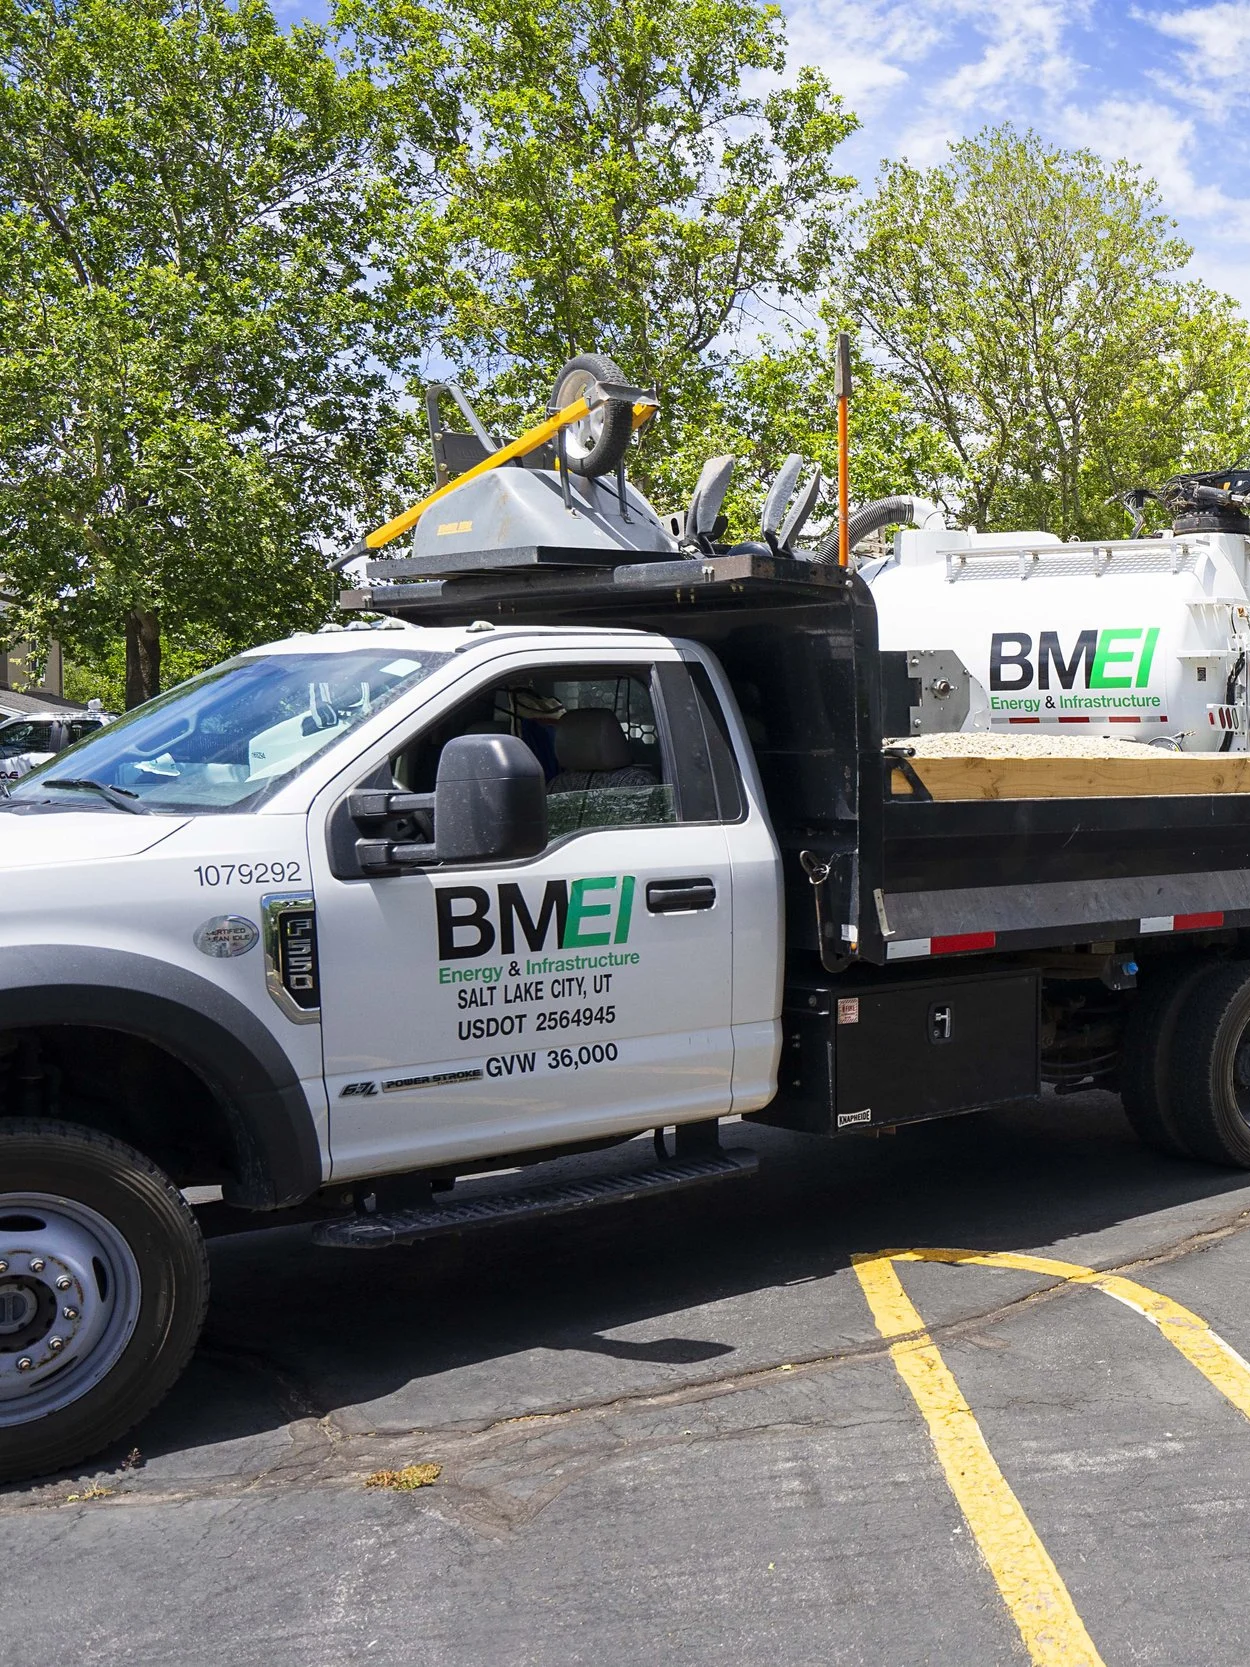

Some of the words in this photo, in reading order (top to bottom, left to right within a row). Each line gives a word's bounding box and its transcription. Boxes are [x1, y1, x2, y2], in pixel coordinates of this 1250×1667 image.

[990, 627, 1160, 691] BMEI
[990, 696, 1041, 712] Energy
[1045, 695, 1056, 709] &
[1060, 694, 1161, 709] Infrastructure
[193, 861, 302, 886] 1079292
[434, 875, 636, 961] BMEI
[438, 965, 503, 984] Energy
[508, 961, 521, 977] &
[526, 952, 640, 975] Infrastructure
[457, 986, 497, 1010] SALT
[503, 980, 544, 1004] LAKE
[551, 976, 587, 999] CITY,
[593, 974, 613, 994] UT
[458, 1013, 527, 1041] USDOT
[535, 1005, 616, 1032] 2564945
[486, 1052, 536, 1078] GVW
[547, 1042, 618, 1070] 36,000
[386, 1074, 432, 1089] POWER
[432, 1069, 481, 1083] STROKE
[839, 1110, 870, 1125] KNAPHEIDE
